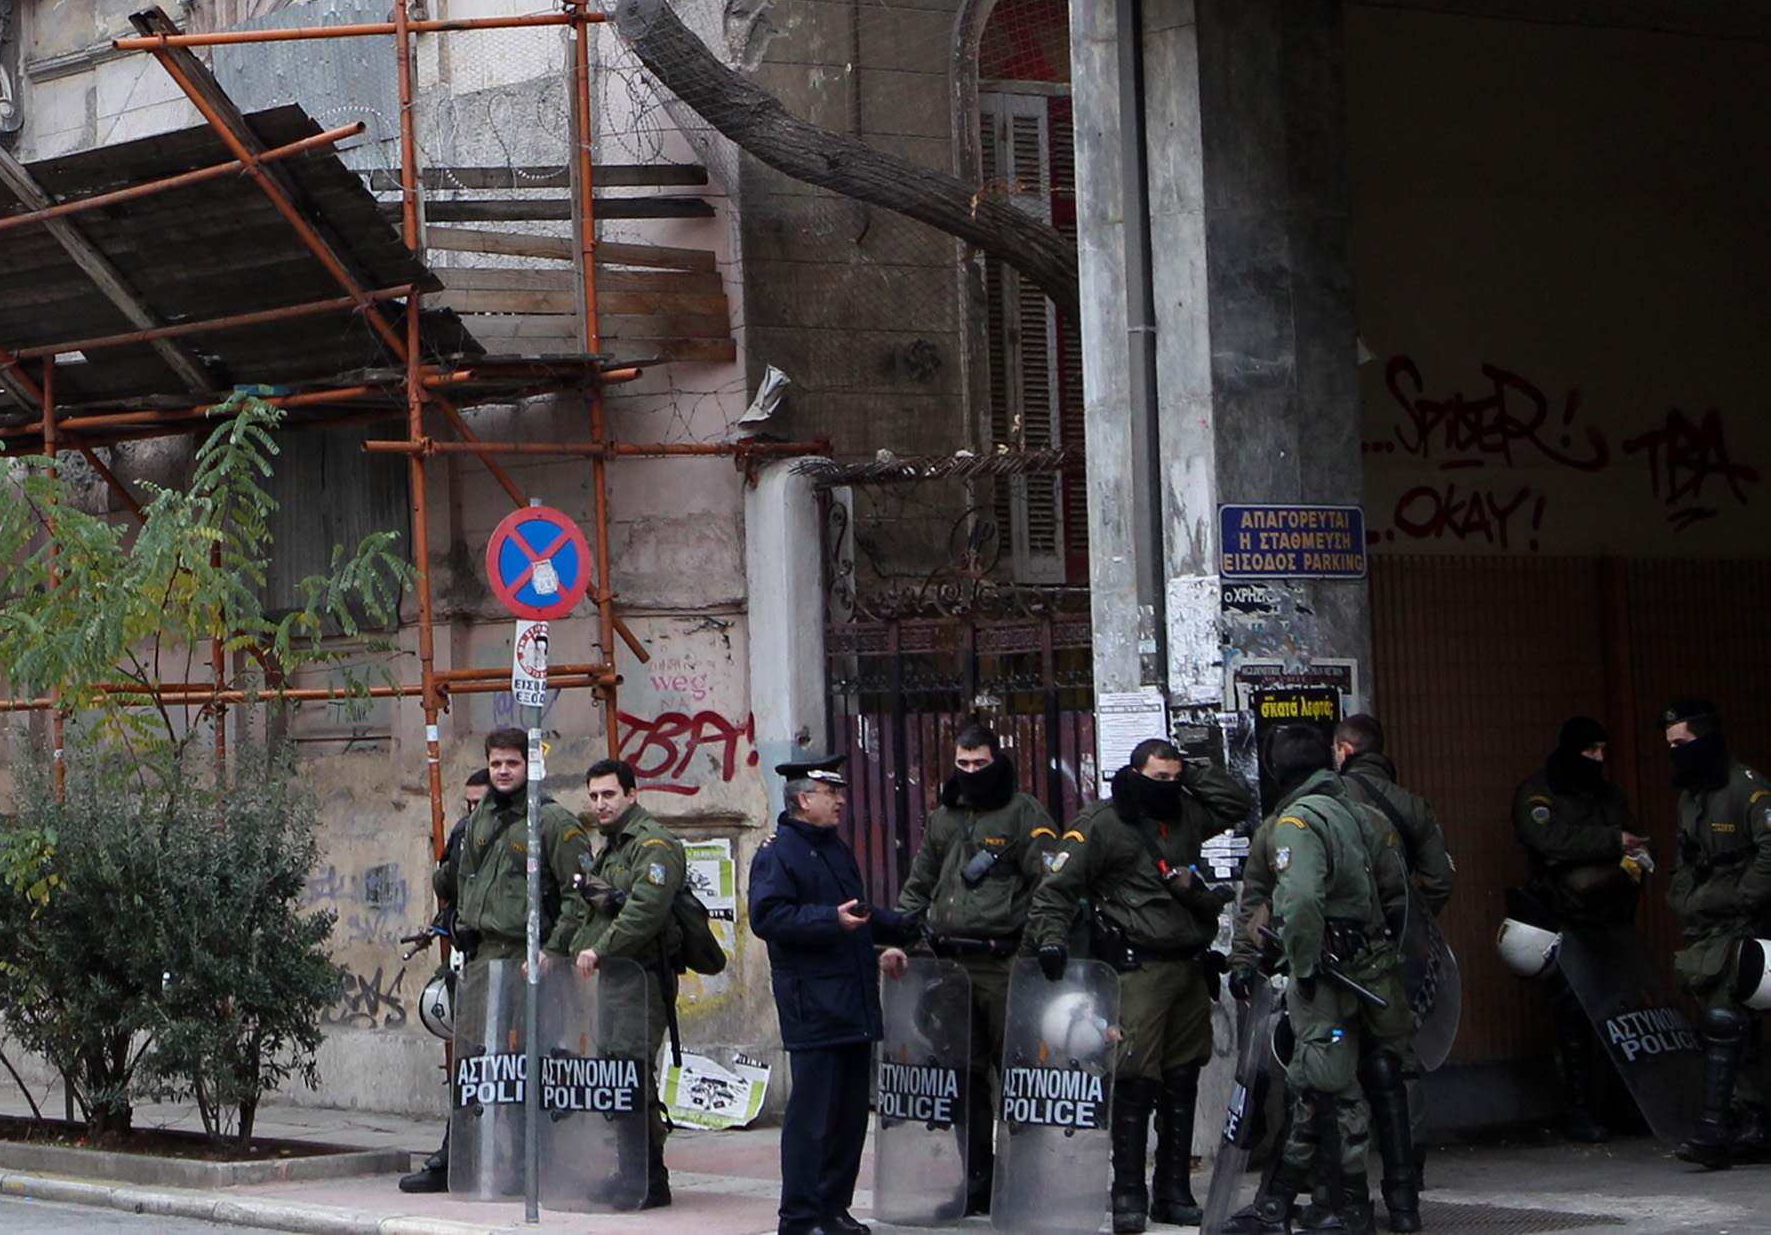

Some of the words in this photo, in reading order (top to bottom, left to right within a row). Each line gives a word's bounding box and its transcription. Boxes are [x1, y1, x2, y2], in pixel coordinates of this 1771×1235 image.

[1241, 511, 1349, 529] ΑΠΑΓΟΡΕΥΤΑΙ
[1239, 532, 1251, 550] Η
[1259, 532, 1351, 550] ΣΤΑΘΜΕΥΣΗ
[1223, 553, 1297, 571] ΕΙΣΟΔΟΣ
[1303, 553, 1365, 571] PARKING
[541, 1058, 639, 1089] ΑΣΤΥΝΟΜΙΑ
[1003, 1068, 1103, 1103] ΑΣΤΥΝΟΜΙΑ
[544, 1087, 633, 1111] POLICE
[1004, 1098, 1095, 1127] POLICE
